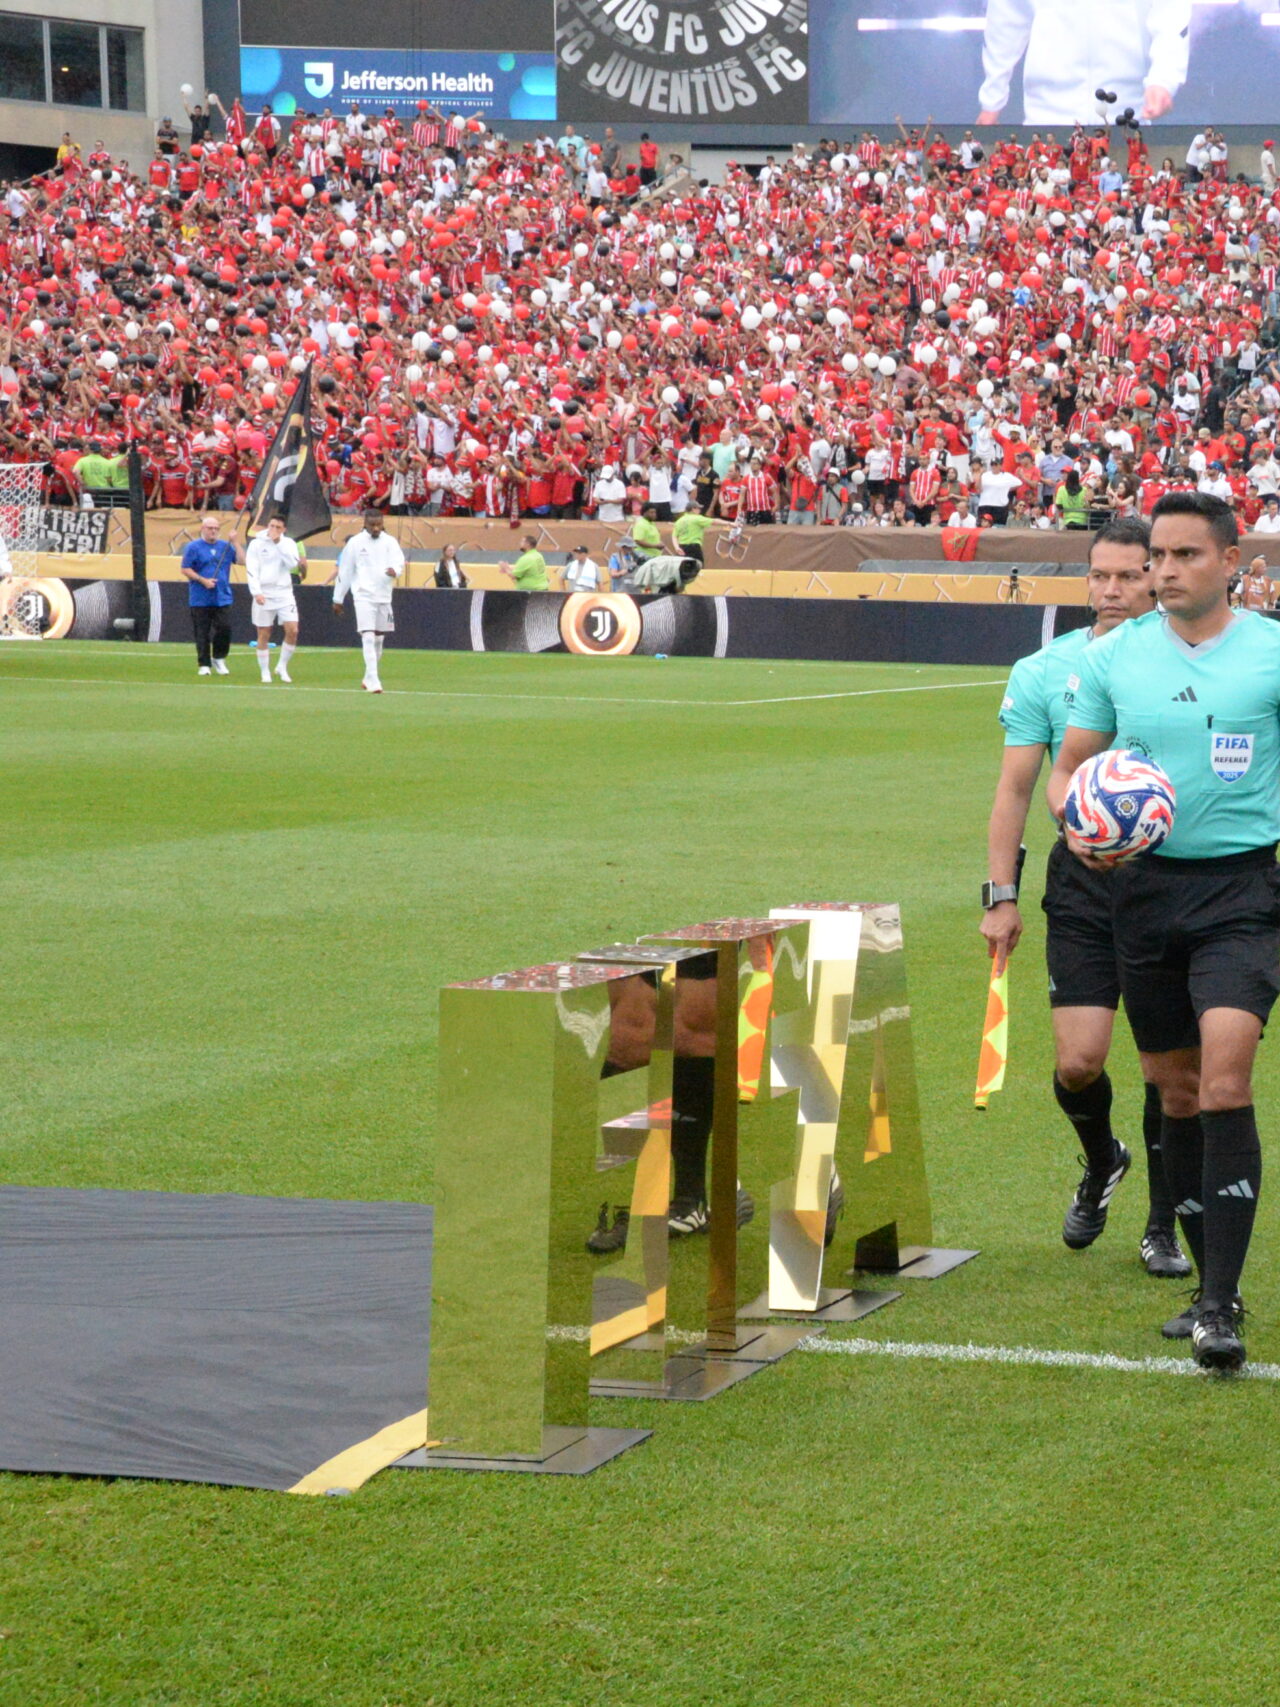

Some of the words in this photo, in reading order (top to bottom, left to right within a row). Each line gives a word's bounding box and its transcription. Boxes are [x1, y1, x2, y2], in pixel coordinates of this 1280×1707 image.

[664, 11, 709, 55] FC
[341, 70, 428, 91] Jefferson
[431, 72, 494, 92] Health
[587, 52, 758, 115] JUVENTUS
[752, 46, 807, 95] FC
[1215, 736, 1250, 750] FIFA
